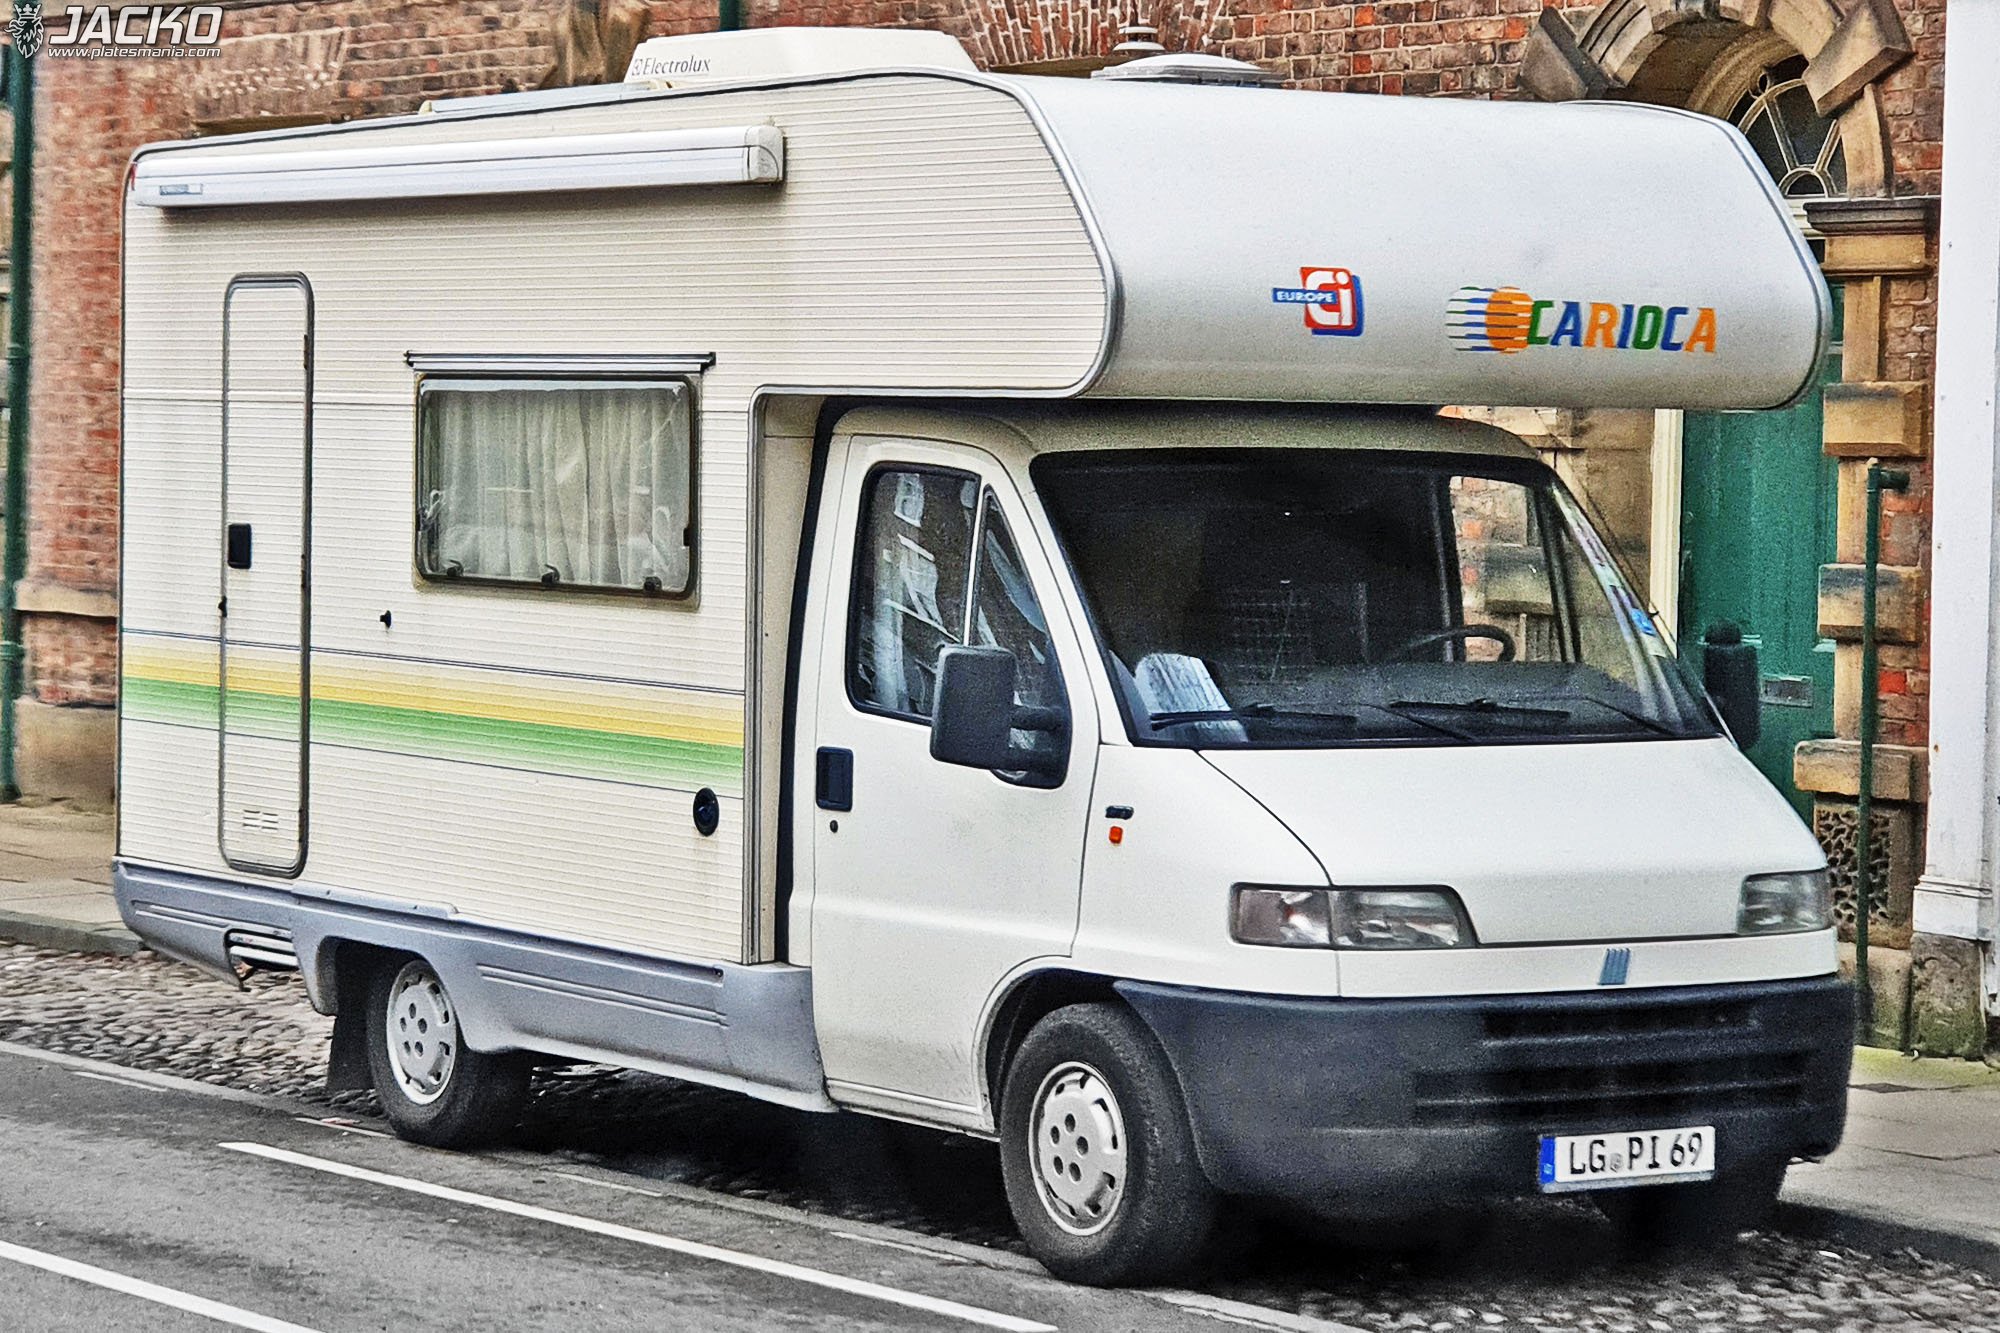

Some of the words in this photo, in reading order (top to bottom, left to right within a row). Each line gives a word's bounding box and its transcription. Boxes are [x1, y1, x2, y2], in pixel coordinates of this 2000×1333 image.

[643, 55, 710, 75] Electrolux
[1276, 291, 1334, 303] EUROPE
[1527, 300, 1717, 353] CARIOCA
[1570, 1139, 1606, 1175] LG
[1627, 1136, 1660, 1170] PI
[1670, 1132, 1702, 1167] 69
